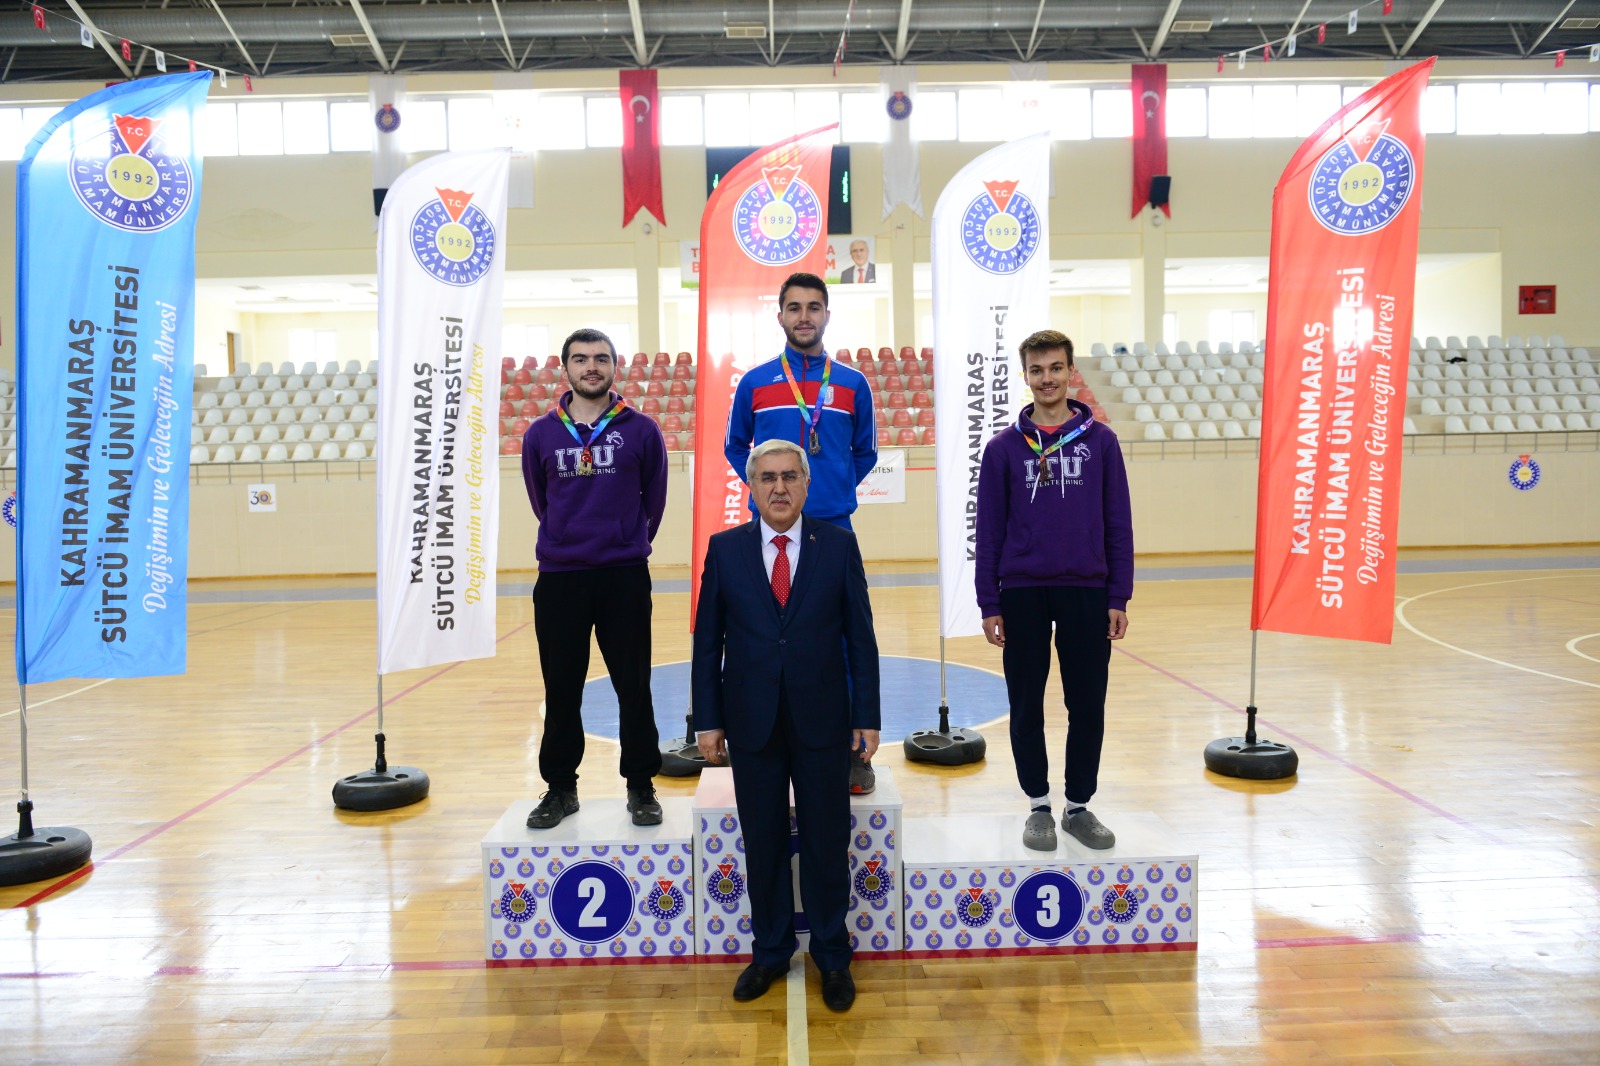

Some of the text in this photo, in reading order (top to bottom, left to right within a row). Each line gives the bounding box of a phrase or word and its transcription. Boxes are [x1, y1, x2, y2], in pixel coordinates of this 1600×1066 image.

[126, 126, 147, 137] T.C.
[93, 142, 172, 212] KHRAMANMARAŞ
[111, 169, 153, 186] 1992
[124, 140, 187, 226] ÜNİVERSİTEİ
[447, 198, 465, 208] T.C.
[772, 177, 788, 185] T.C.
[1343, 177, 1379, 190] 1992
[440, 236, 471, 248] 1992
[763, 216, 792, 225] 1992
[989, 227, 1017, 236] 1992
[101, 265, 139, 459] ÜNİVERSİTESİ
[437, 316, 463, 477] ÜNİVERSİTESİ
[61, 318, 101, 586] KAHRAMANMARAŞ
[142, 300, 179, 613] Değişimin ve Geleceğin Adresi
[1290, 321, 1330, 554] KAHRAMANMARAŞ
[1356, 293, 1395, 585] Değişimin ve Geleceğin Adresi
[410, 362, 438, 584] KAHRAMANMARAŞ
[464, 343, 487, 605] Değişimin ve Geleceğin Adresi
[558, 467, 616, 478] ORIENERING
[1319, 452, 1350, 520] İMAM
[98, 469, 133, 543] İMAM
[431, 484, 454, 547] İMAM
[577, 876, 607, 928] 2
[1036, 884, 1061, 928] 3
